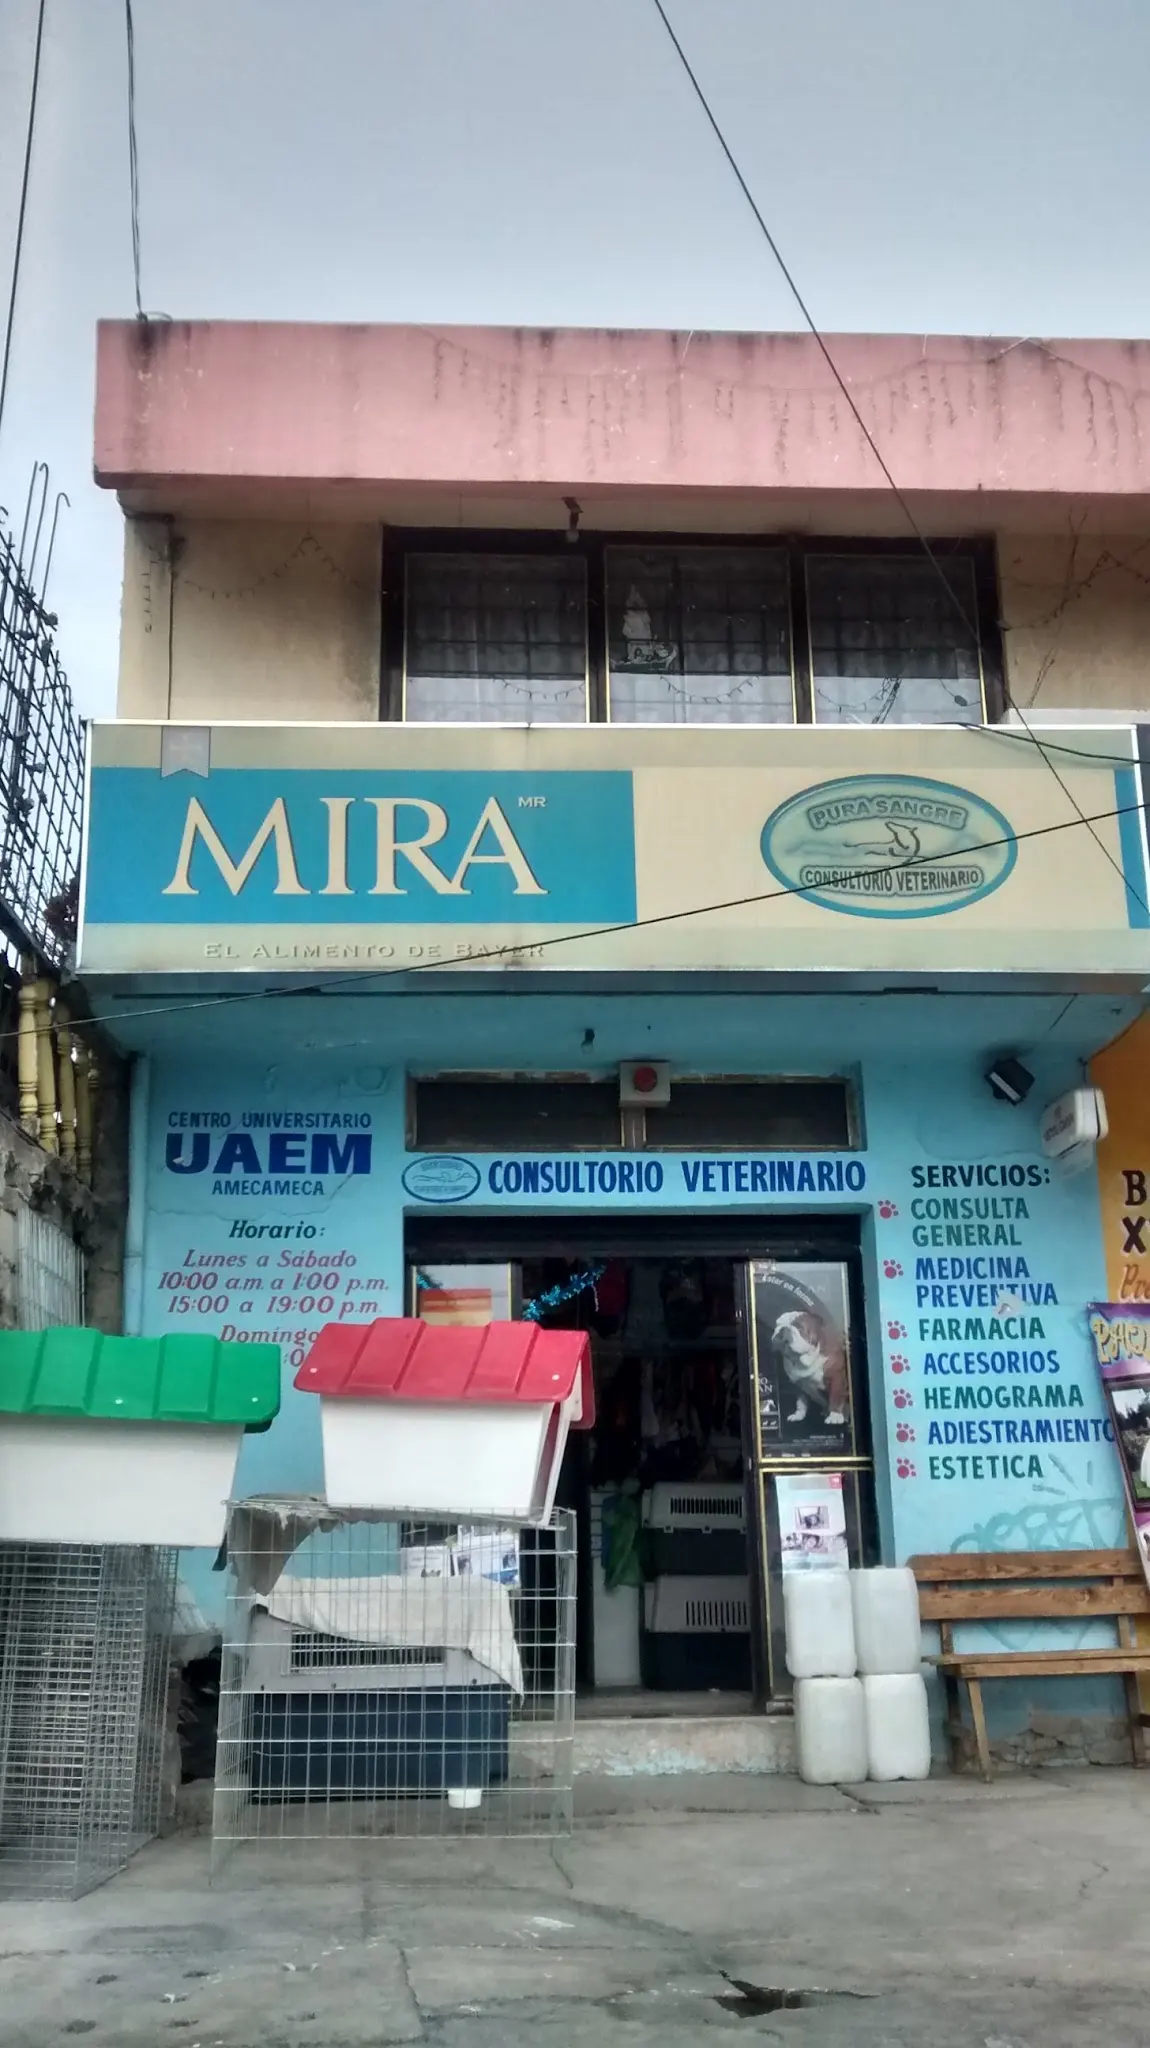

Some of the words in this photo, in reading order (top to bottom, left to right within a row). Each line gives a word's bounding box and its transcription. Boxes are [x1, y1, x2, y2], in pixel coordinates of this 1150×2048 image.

[518, 796, 547, 808] MR
[812, 800, 871, 825] PURA
[875, 799, 963, 824] SANGRE
[161, 796, 550, 897] MIRA
[804, 869, 894, 892] CONSULTORIO
[896, 869, 980, 892] VETERINARIO
[168, 1111, 231, 1128] CENTRO
[241, 1112, 372, 1129] UNIVERSITARIO
[165, 1132, 373, 1175] UAEM
[211, 1179, 325, 1196] AMECAMECA
[488, 1160, 664, 1194] CONSULTORIO
[680, 1159, 867, 1193] VETERINARIO
[910, 1164, 1051, 1189] SERVICIOS:
[1121, 1169, 1148, 1206] B
[910, 1196, 1030, 1221] CONSULTA
[228, 1219, 326, 1240] Horario:
[911, 1224, 1023, 1248] GENERAL
[182, 1248, 247, 1269] Lunes
[256, 1254, 270, 1268] a
[276, 1248, 358, 1268] Sábado
[915, 1256, 1031, 1281] MEDICINA
[157, 1271, 219, 1291] 10:00
[269, 1277, 285, 1291] a
[291, 1271, 340, 1291] 1:00
[345, 1276, 391, 1298] p.m.
[916, 1282, 1060, 1309] PREVENTIVA
[167, 1294, 230, 1314] 15:00
[238, 1299, 254, 1314] a
[265, 1294, 335, 1315] 19:00
[338, 1299, 384, 1321] p.m.
[219, 1324, 320, 1348] Domingo
[918, 1316, 1046, 1342] FARMACIA
[923, 1349, 1061, 1376] ACCESORIOS
[923, 1384, 1085, 1410] HEMOGRAMA
[927, 1418, 1116, 1446] ADIESTRAMIENTO
[928, 1454, 1045, 1480] ESTETICA
